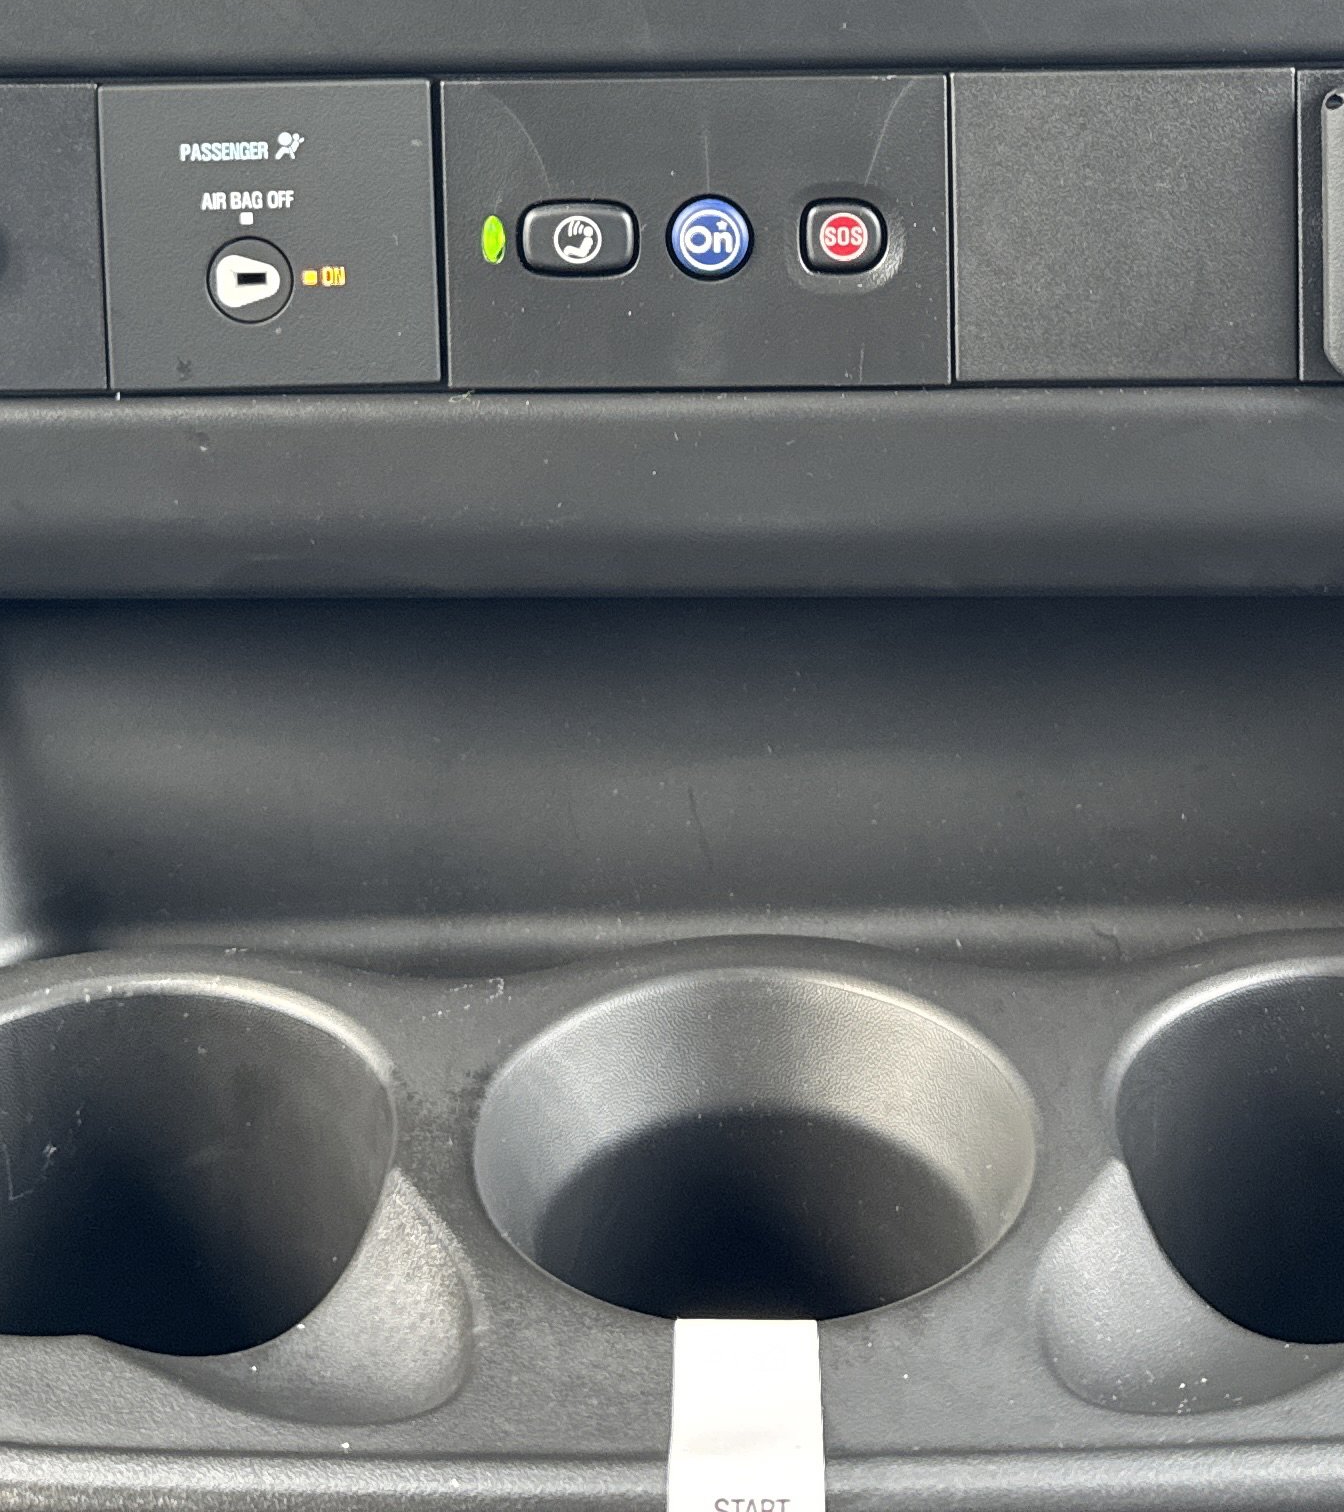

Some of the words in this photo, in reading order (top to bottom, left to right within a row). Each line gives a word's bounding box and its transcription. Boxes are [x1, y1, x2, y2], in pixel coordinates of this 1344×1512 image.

[179, 141, 269, 161] PASSENGER
[201, 192, 227, 211] AIR
[229, 191, 263, 210] BAG
[267, 190, 294, 208] OFF
[684, 223, 732, 254] On
[824, 226, 864, 247] SOS
[321, 266, 346, 286] ON
